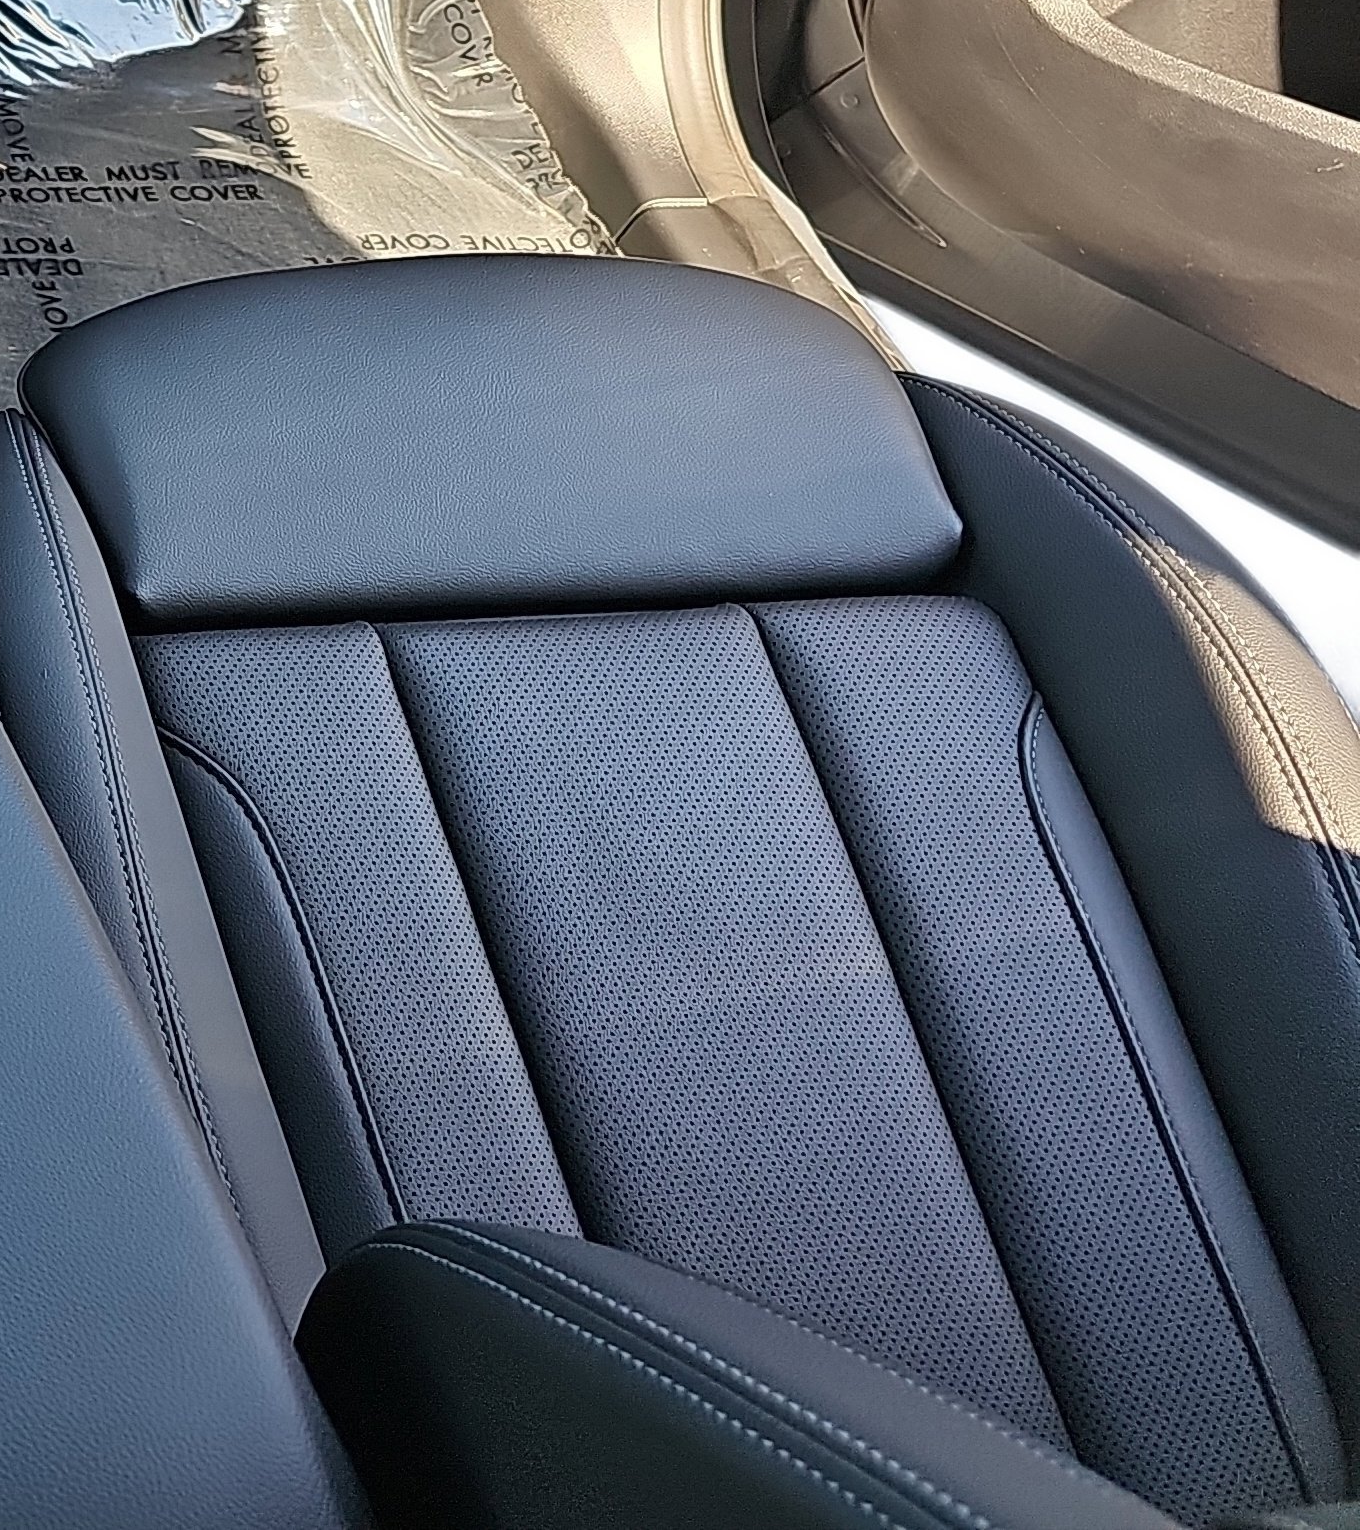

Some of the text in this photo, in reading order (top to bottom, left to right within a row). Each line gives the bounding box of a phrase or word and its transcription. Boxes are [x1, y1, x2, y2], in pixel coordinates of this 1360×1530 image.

[106, 161, 180, 181] MUST
[170, 184, 264, 202] COVER
[357, 233, 450, 250] COVER
